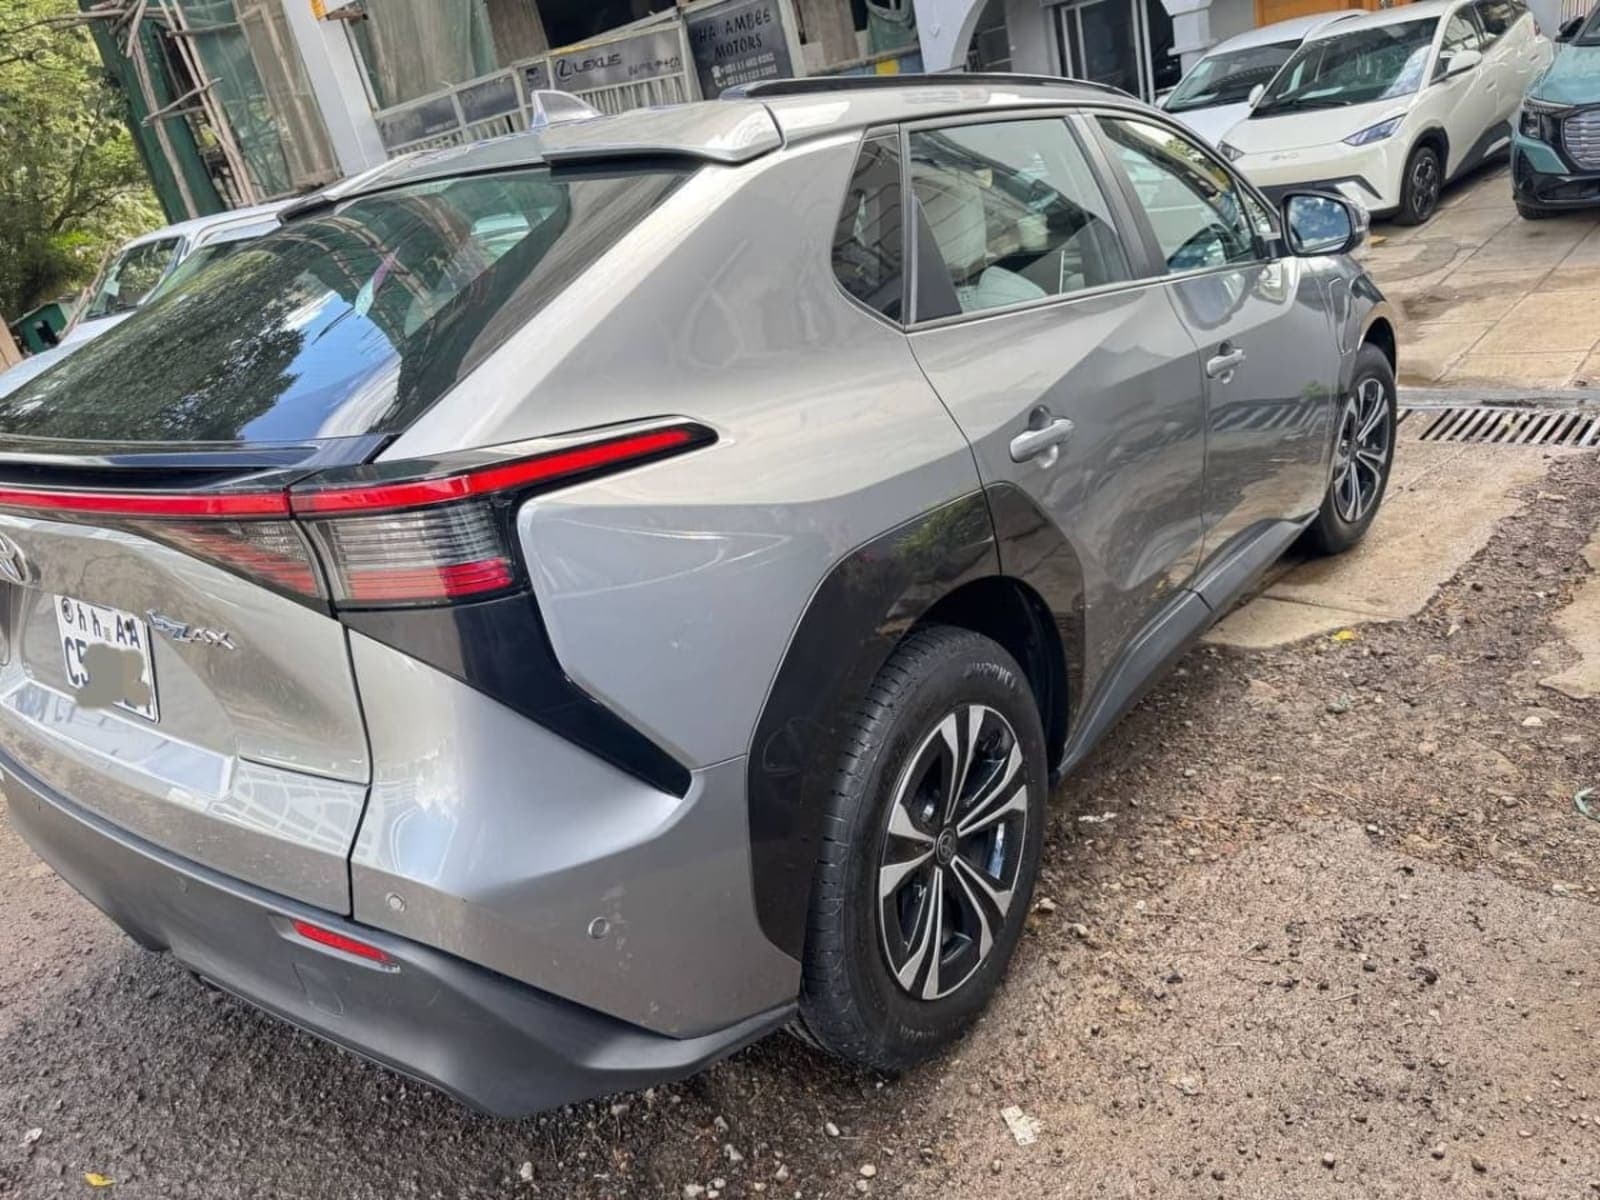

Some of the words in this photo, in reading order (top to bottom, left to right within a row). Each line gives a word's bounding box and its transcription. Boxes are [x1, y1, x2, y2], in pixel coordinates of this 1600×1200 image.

[714, 33, 763, 61] MOTORS
[573, 52, 622, 73] LEXUS
[116, 614, 141, 649] AA
